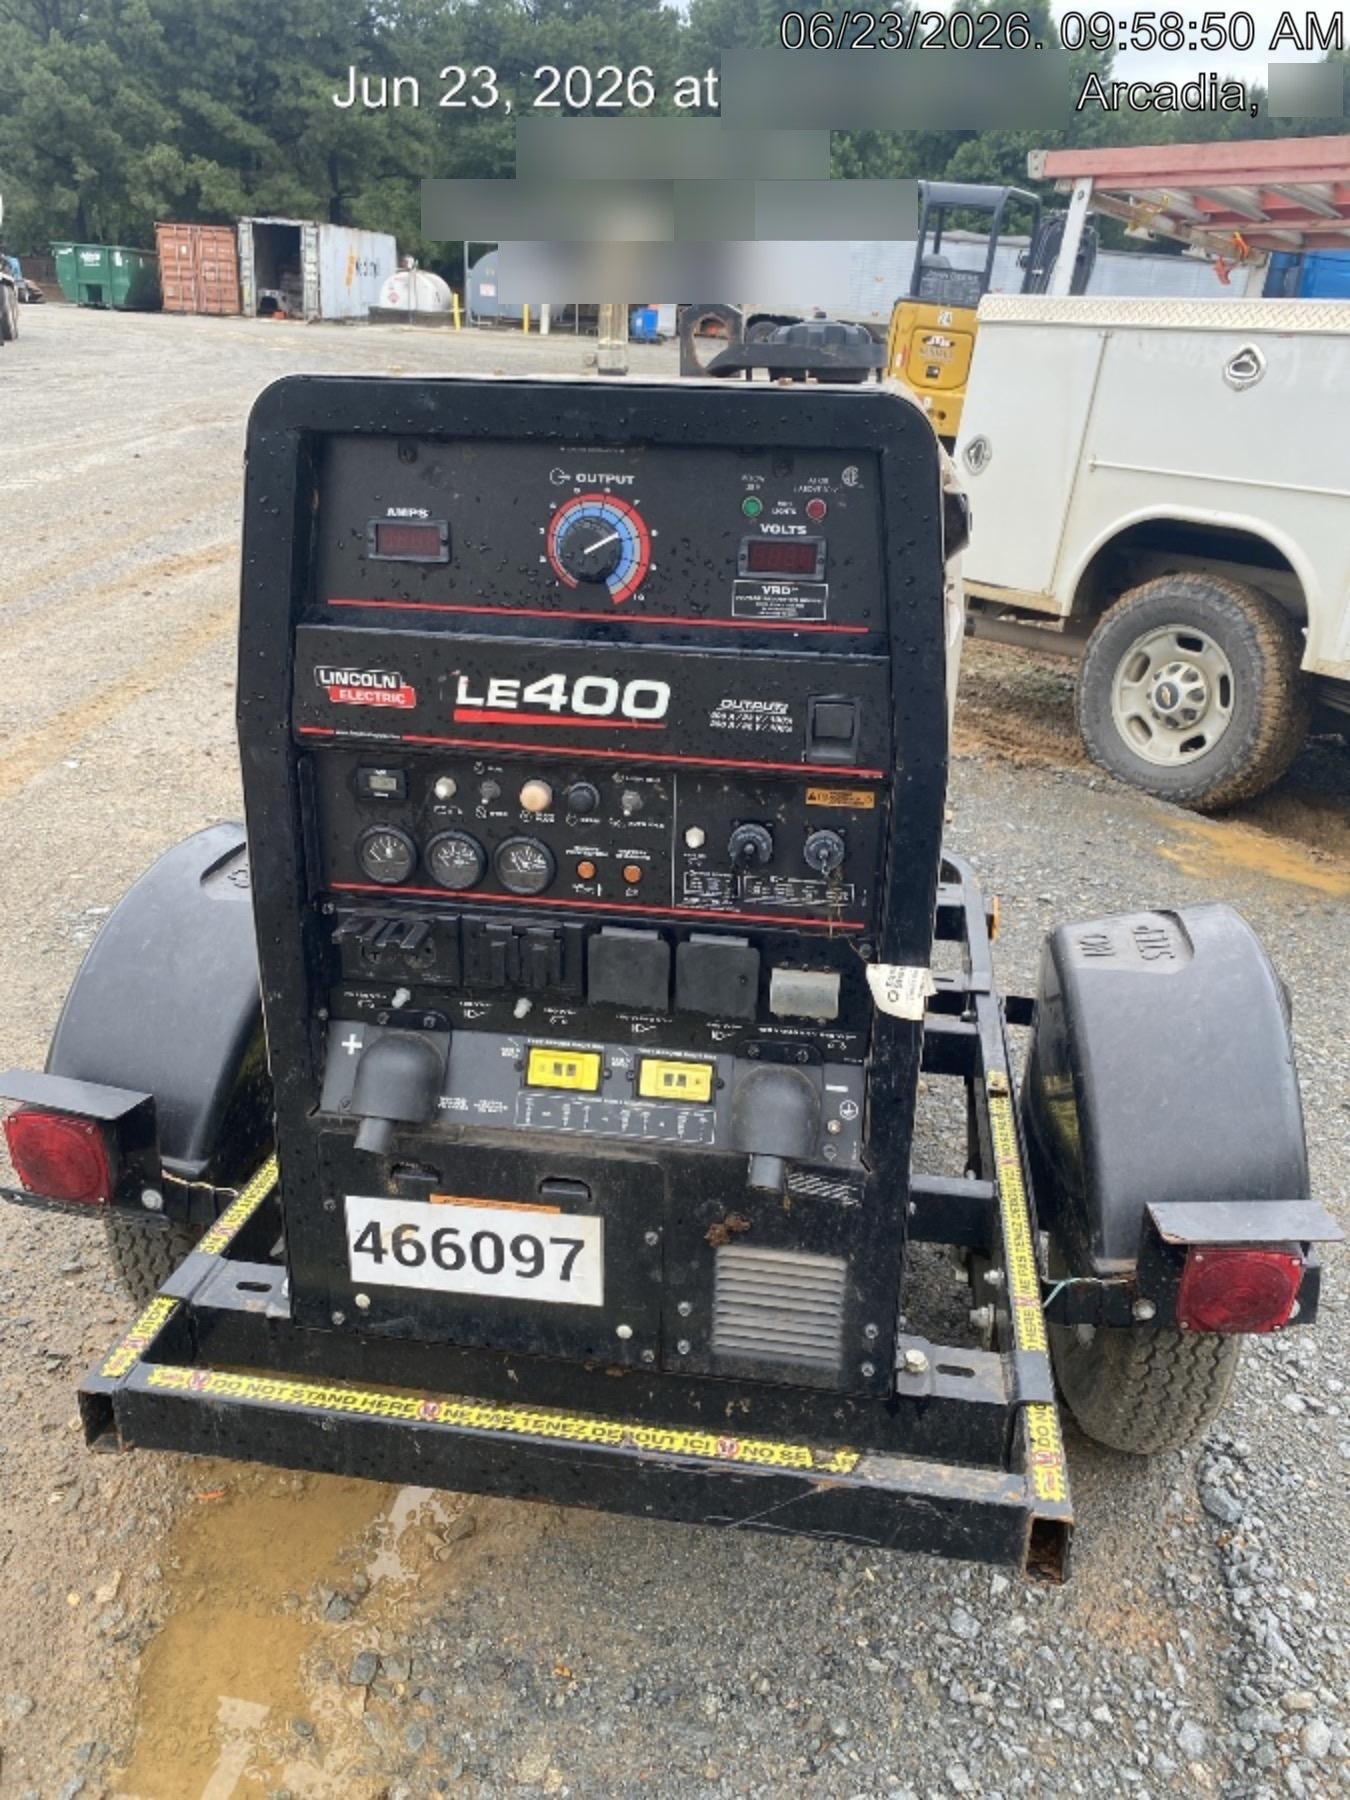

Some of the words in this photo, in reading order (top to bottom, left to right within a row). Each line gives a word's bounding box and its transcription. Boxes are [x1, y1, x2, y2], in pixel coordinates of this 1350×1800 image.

[575, 473, 636, 485] OUTPUT
[387, 508, 429, 519] AMPS
[760, 523, 807, 535] VOLTS
[319, 673, 396, 689] LINCOLN
[339, 689, 406, 705] ELECTRIC
[456, 673, 671, 719] LE400
[1132, 925, 1177, 961] STEP
[353, 1220, 585, 1282] 466097
[213, 1379, 243, 1391] DO
[246, 1382, 288, 1397] NOT
[290, 1389, 355, 1406] STAND
[361, 1396, 416, 1413] HERE
[444, 1408, 469, 1419] NE
[476, 1413, 515, 1426] PAS
[523, 1417, 588, 1435] TENEZ
[591, 1427, 677, 1446] DEOUT
[683, 1439, 710, 1450] ICI
[1036, 1428, 1050, 1448] DO
[743, 1446, 775, 1458] NO
